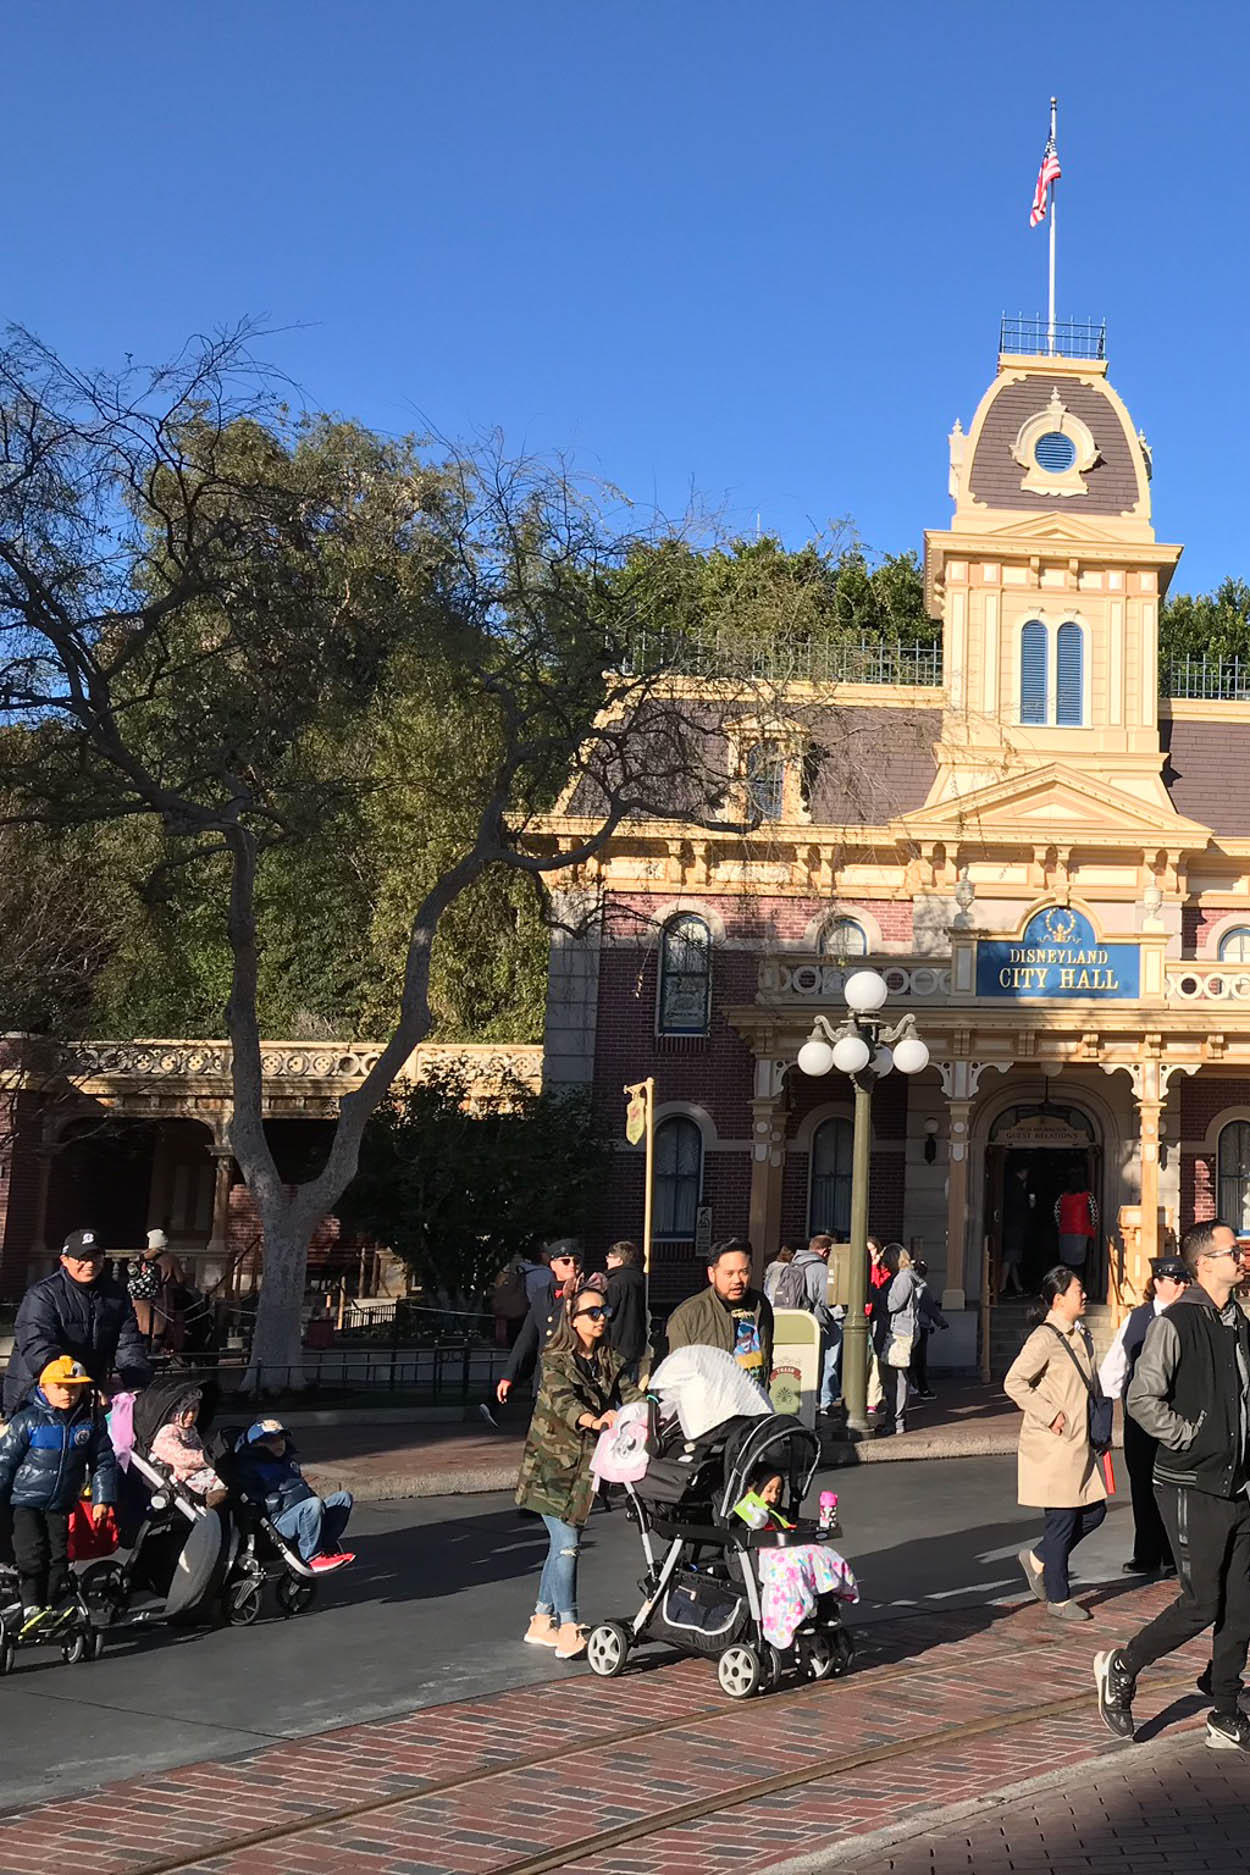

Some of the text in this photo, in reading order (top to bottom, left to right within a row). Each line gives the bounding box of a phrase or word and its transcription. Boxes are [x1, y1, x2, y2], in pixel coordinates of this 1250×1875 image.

[1009, 949, 1108, 964] DISNEYLAND
[999, 967, 1119, 990] CITY HALL
[1035, 1131, 1078, 1140] RELATIONS
